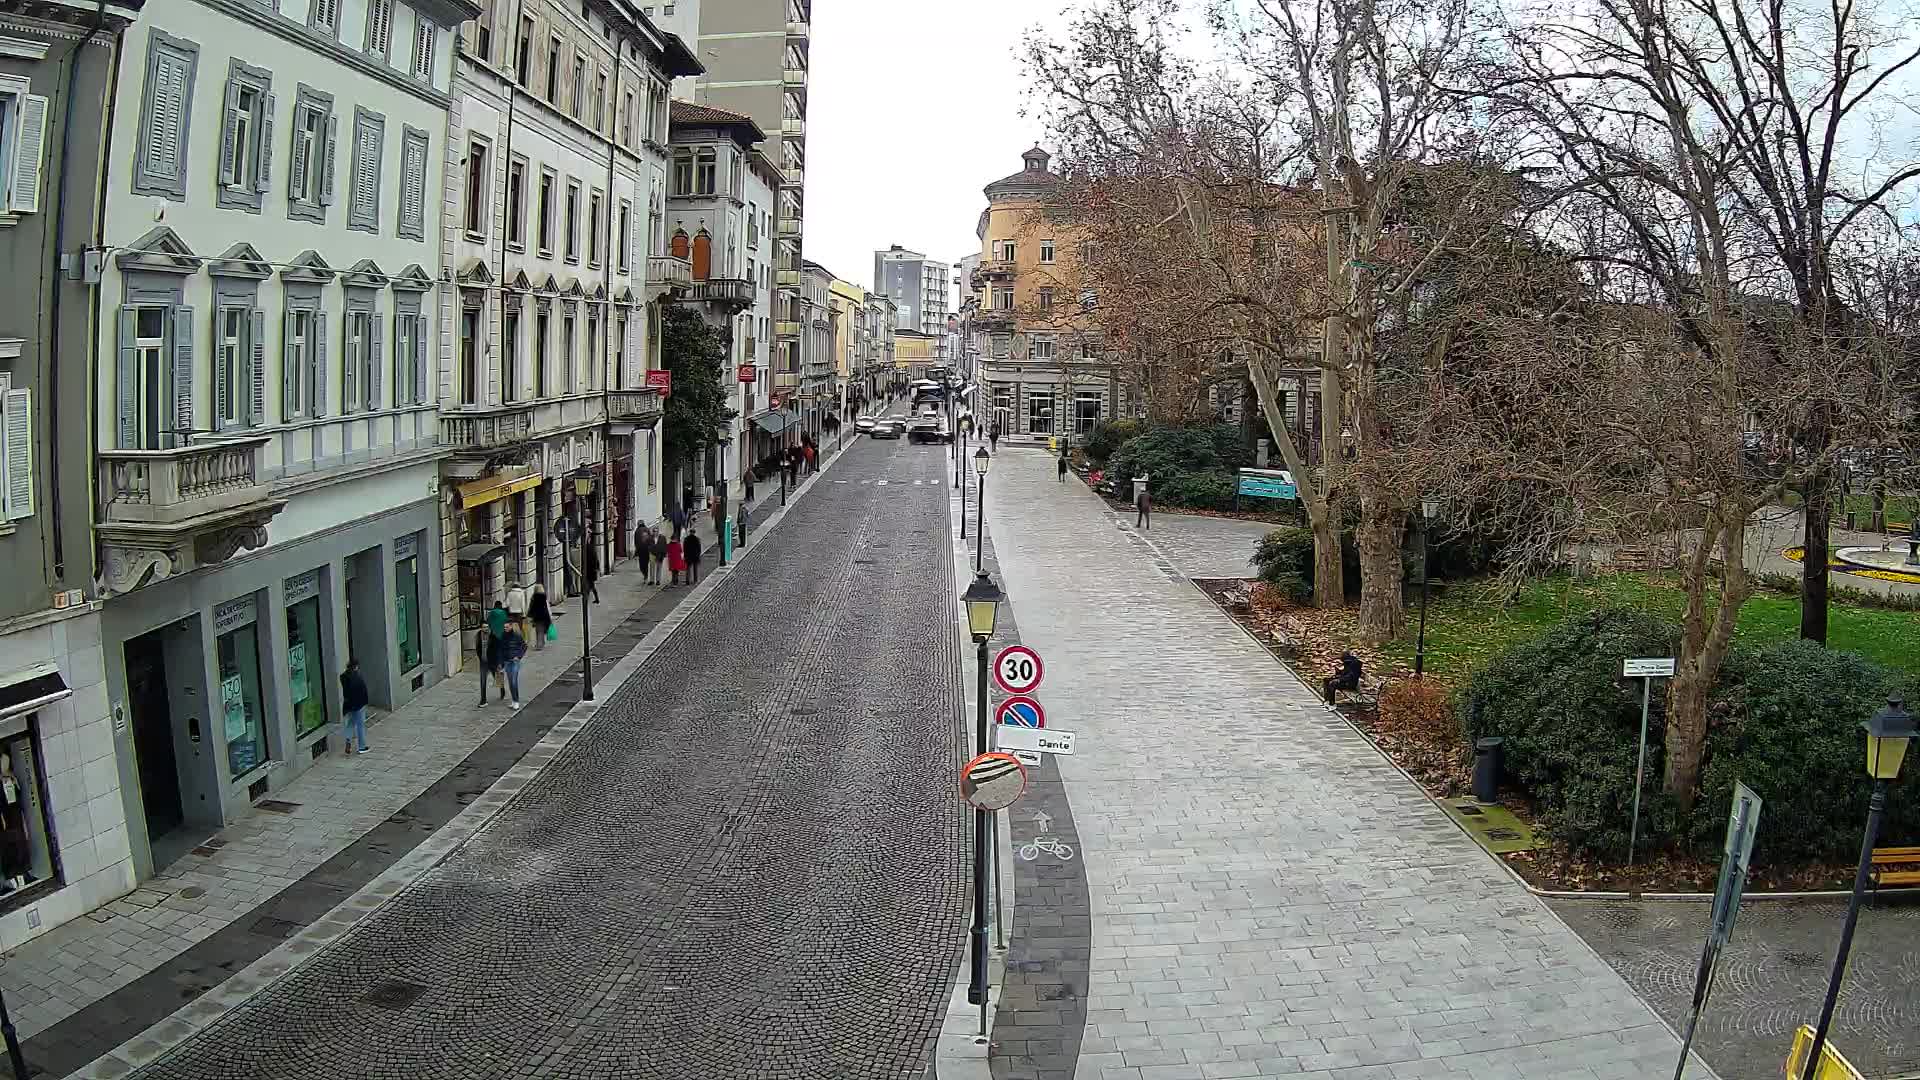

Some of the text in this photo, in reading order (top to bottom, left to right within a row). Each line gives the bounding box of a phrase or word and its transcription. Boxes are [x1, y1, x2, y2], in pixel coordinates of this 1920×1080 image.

[1005, 659, 1033, 681] 30
[223, 678, 241, 701] 130
[1039, 738, 1069, 750] Dante
